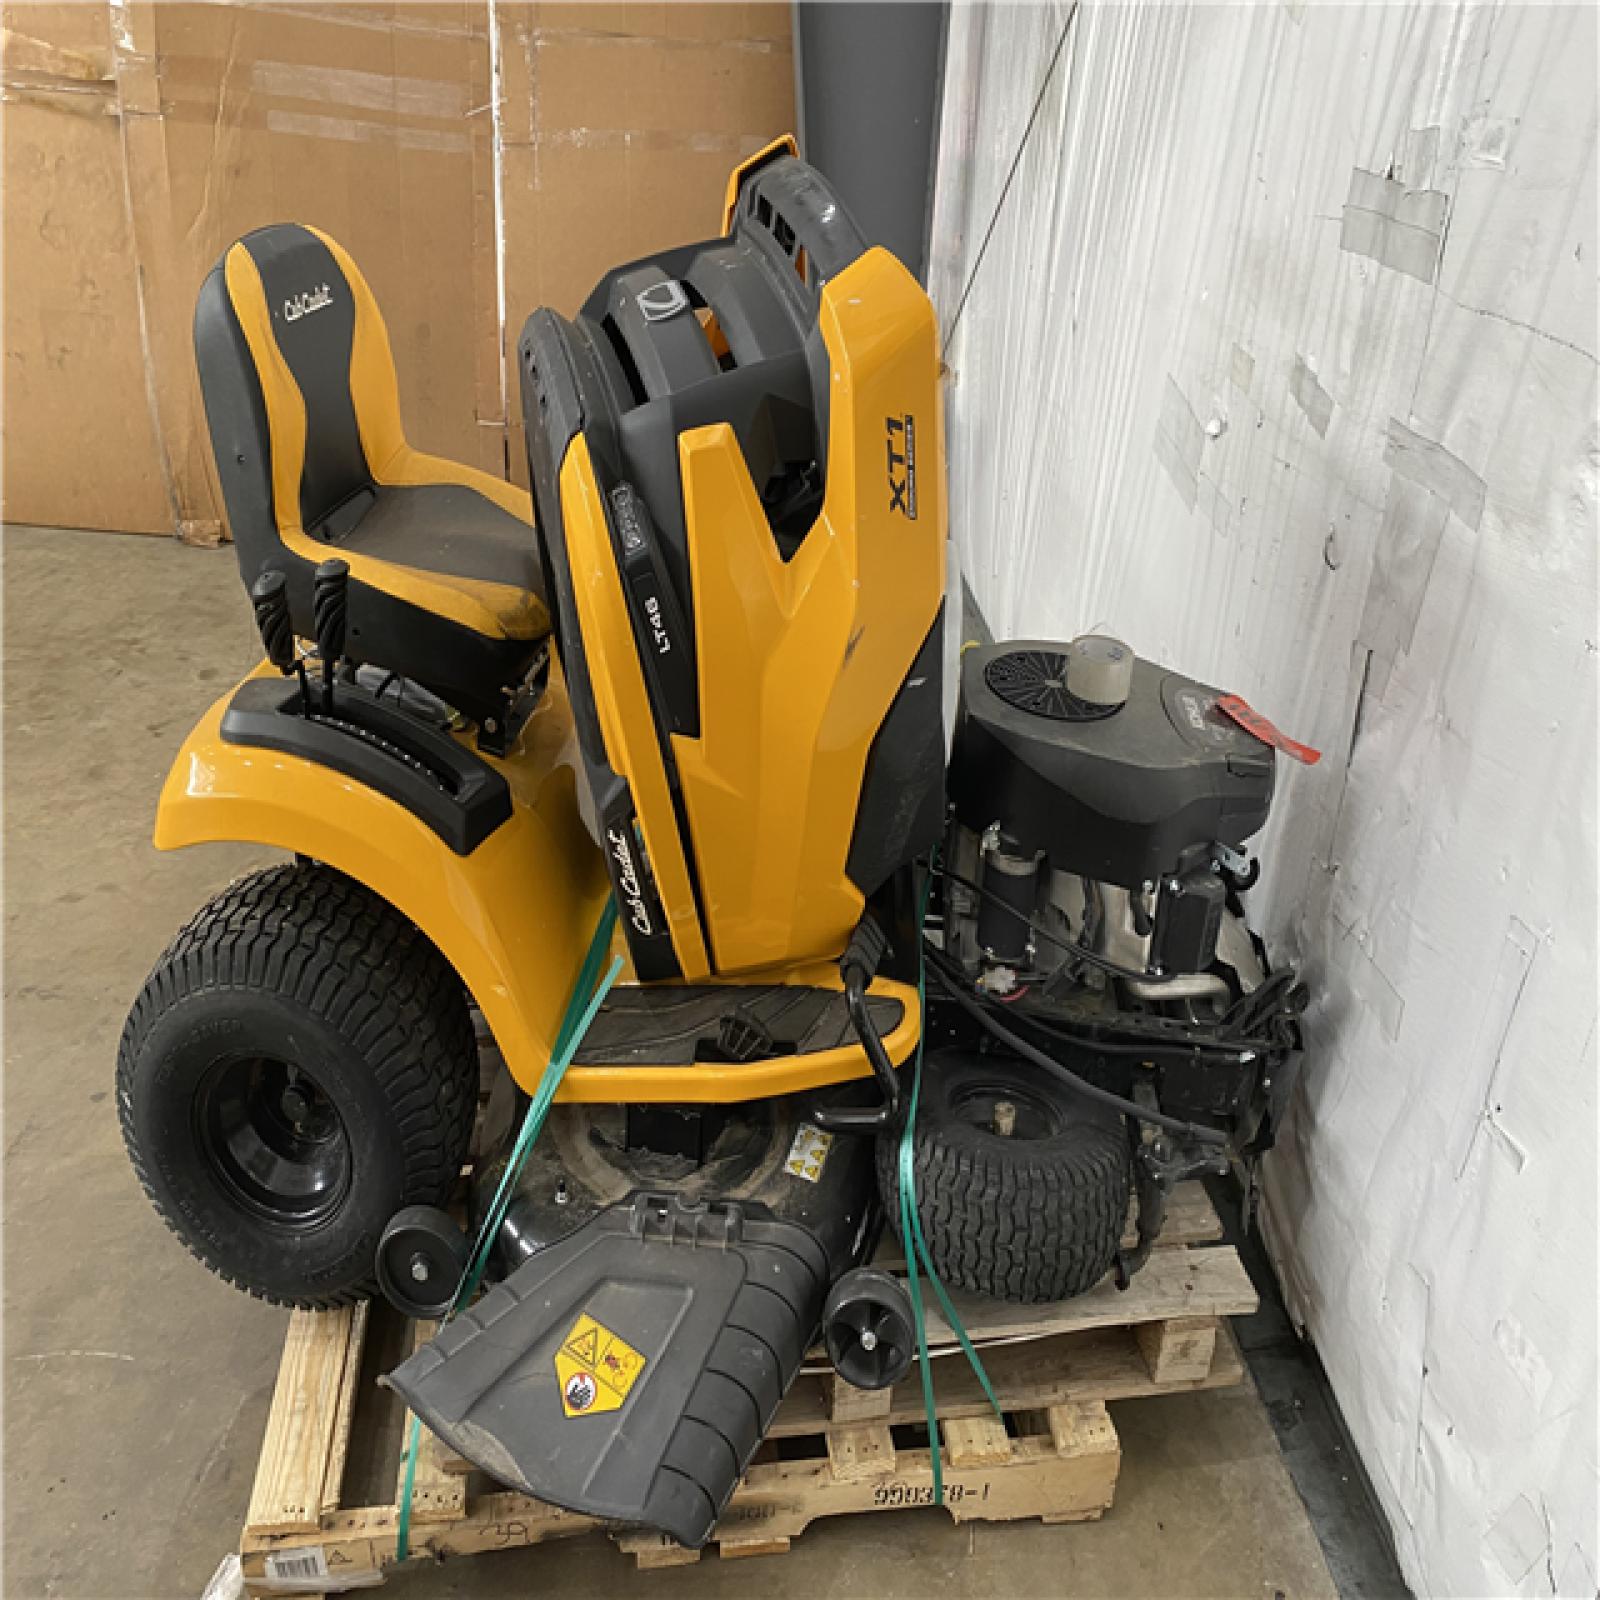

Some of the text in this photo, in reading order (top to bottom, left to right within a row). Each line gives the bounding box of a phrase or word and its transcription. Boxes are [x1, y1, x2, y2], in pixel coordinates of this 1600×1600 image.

[886, 416, 906, 513] XT1
[607, 829, 651, 936] Cub Cadet
